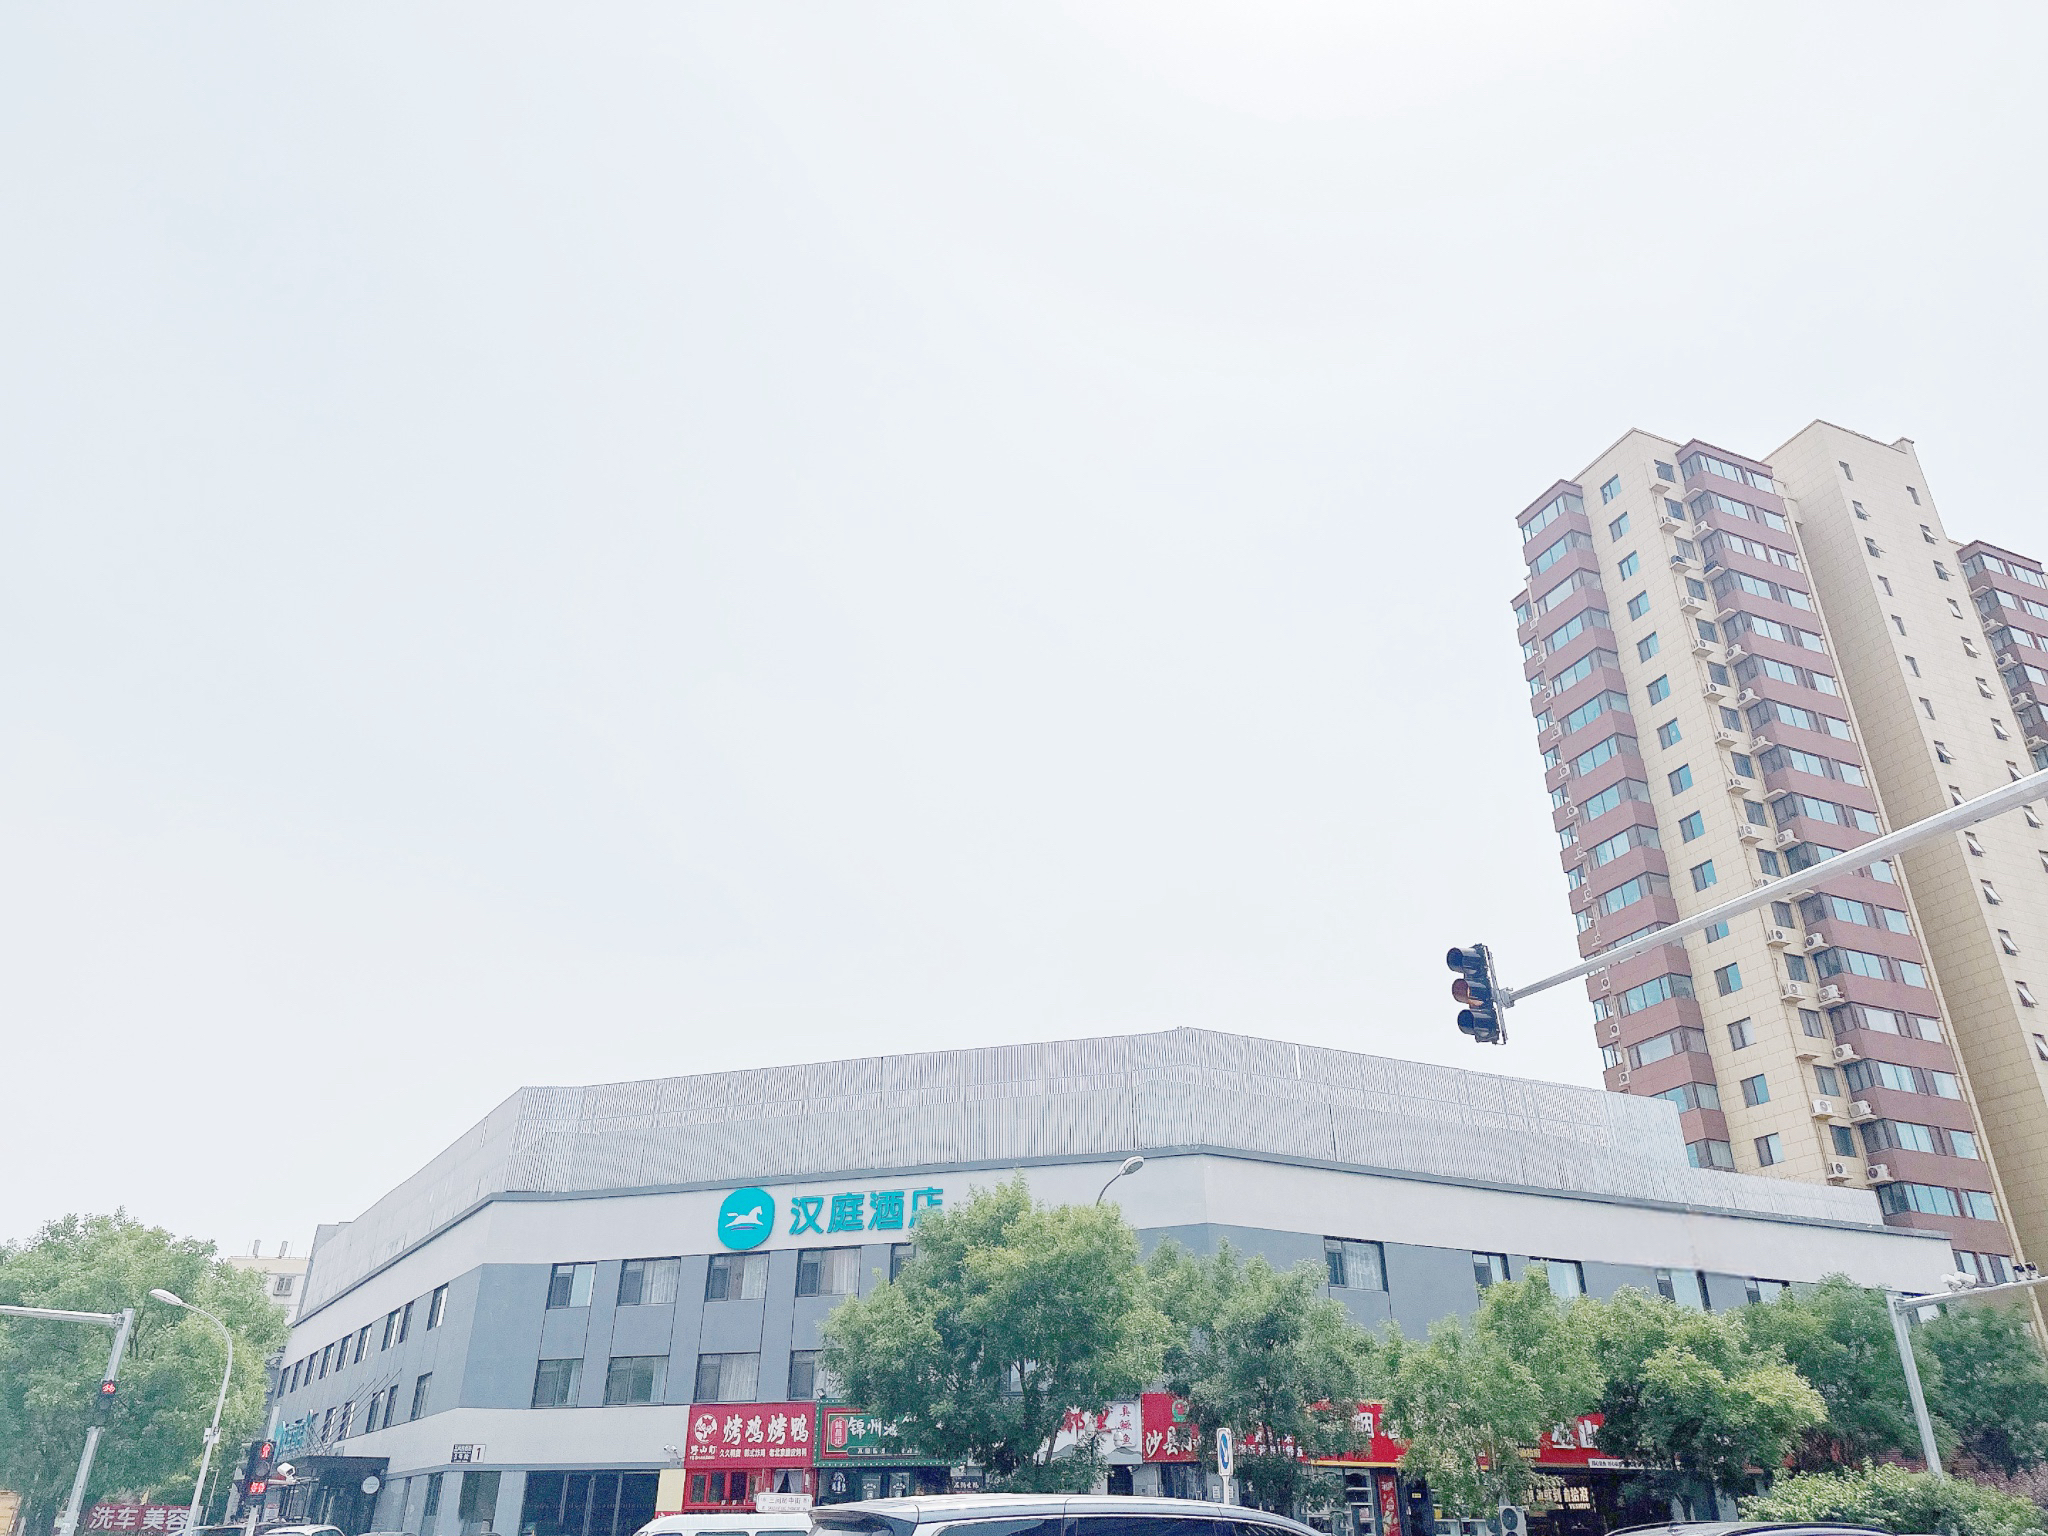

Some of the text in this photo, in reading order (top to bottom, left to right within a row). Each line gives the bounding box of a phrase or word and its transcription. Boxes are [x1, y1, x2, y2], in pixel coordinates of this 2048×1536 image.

[789, 1187, 944, 1235] 汉庭酒店
[722, 1412, 810, 1445] 烤鸡烤鸭
[89, 1506, 190, 1531] 洗车 美容
